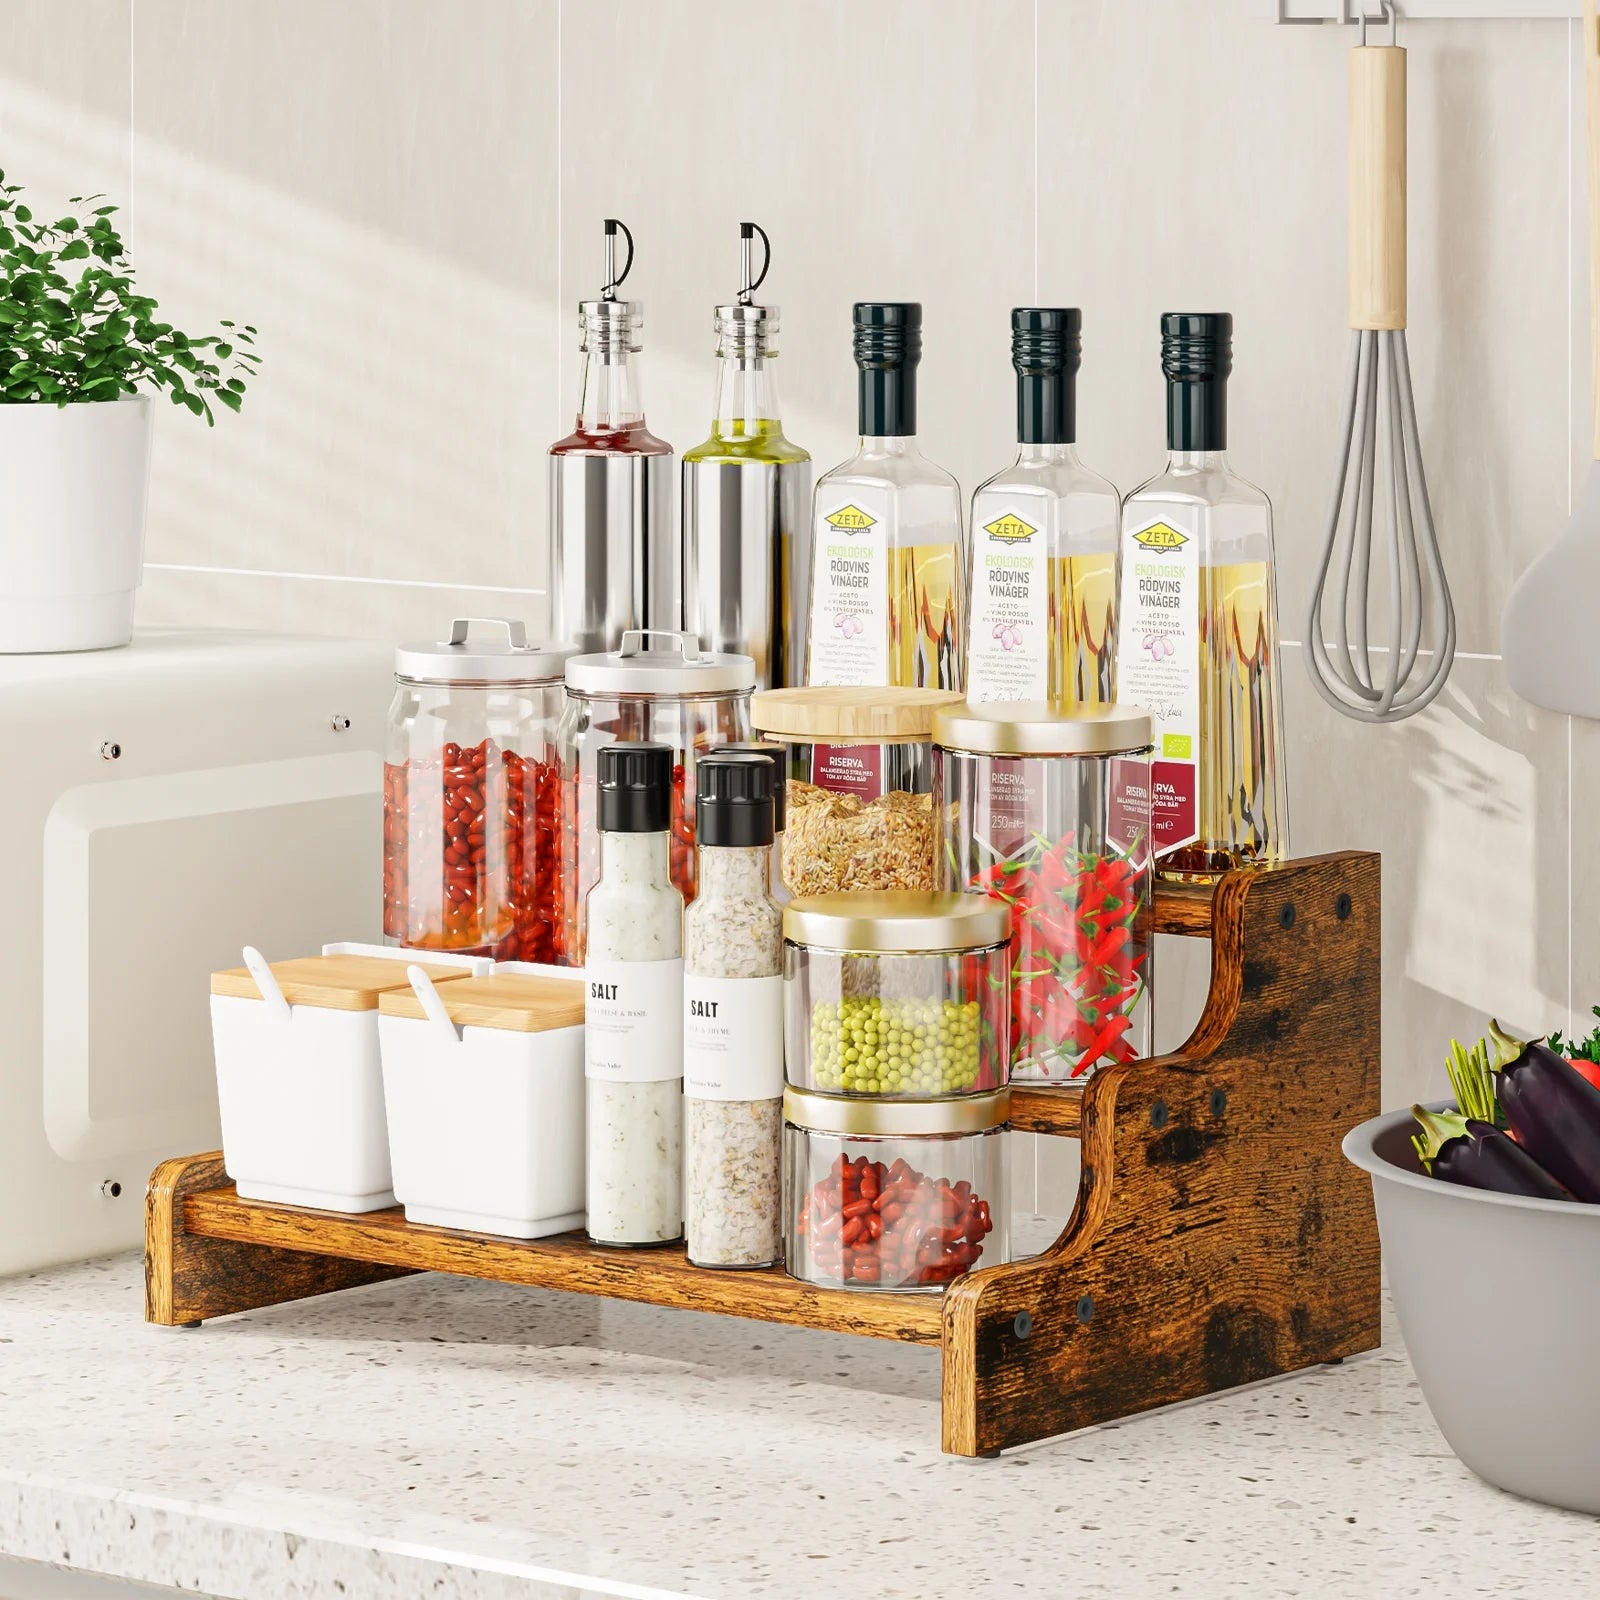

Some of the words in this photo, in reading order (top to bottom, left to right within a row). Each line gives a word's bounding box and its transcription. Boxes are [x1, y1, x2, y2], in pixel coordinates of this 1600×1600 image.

[837, 514, 866, 526] ZETA
[995, 523, 1025, 535] ZETA
[1145, 532, 1177, 544] ZETA
[827, 545, 874, 559] EKOLOGISK
[830, 557, 870, 574] RÖDVINS
[985, 554, 1034, 569] EKOLOGISK
[989, 567, 1030, 584] RÖDVINS
[1135, 563, 1186, 578] EKOLOGISK
[830, 573, 869, 589] VINÄGER
[1139, 576, 1181, 593] RÖDVINS
[989, 583, 1029, 599] VINÄGER
[1139, 592, 1180, 609] VINÄGER
[1008, 610, 1029, 618] ROSSO
[1148, 612, 1169, 620] ACETO
[1158, 620, 1181, 628] ROSSO
[829, 756, 864, 768] RISERVA
[991, 772, 1025, 785] RISERVA
[591, 982, 618, 1001] SALT
[691, 999, 719, 1018] SALT
